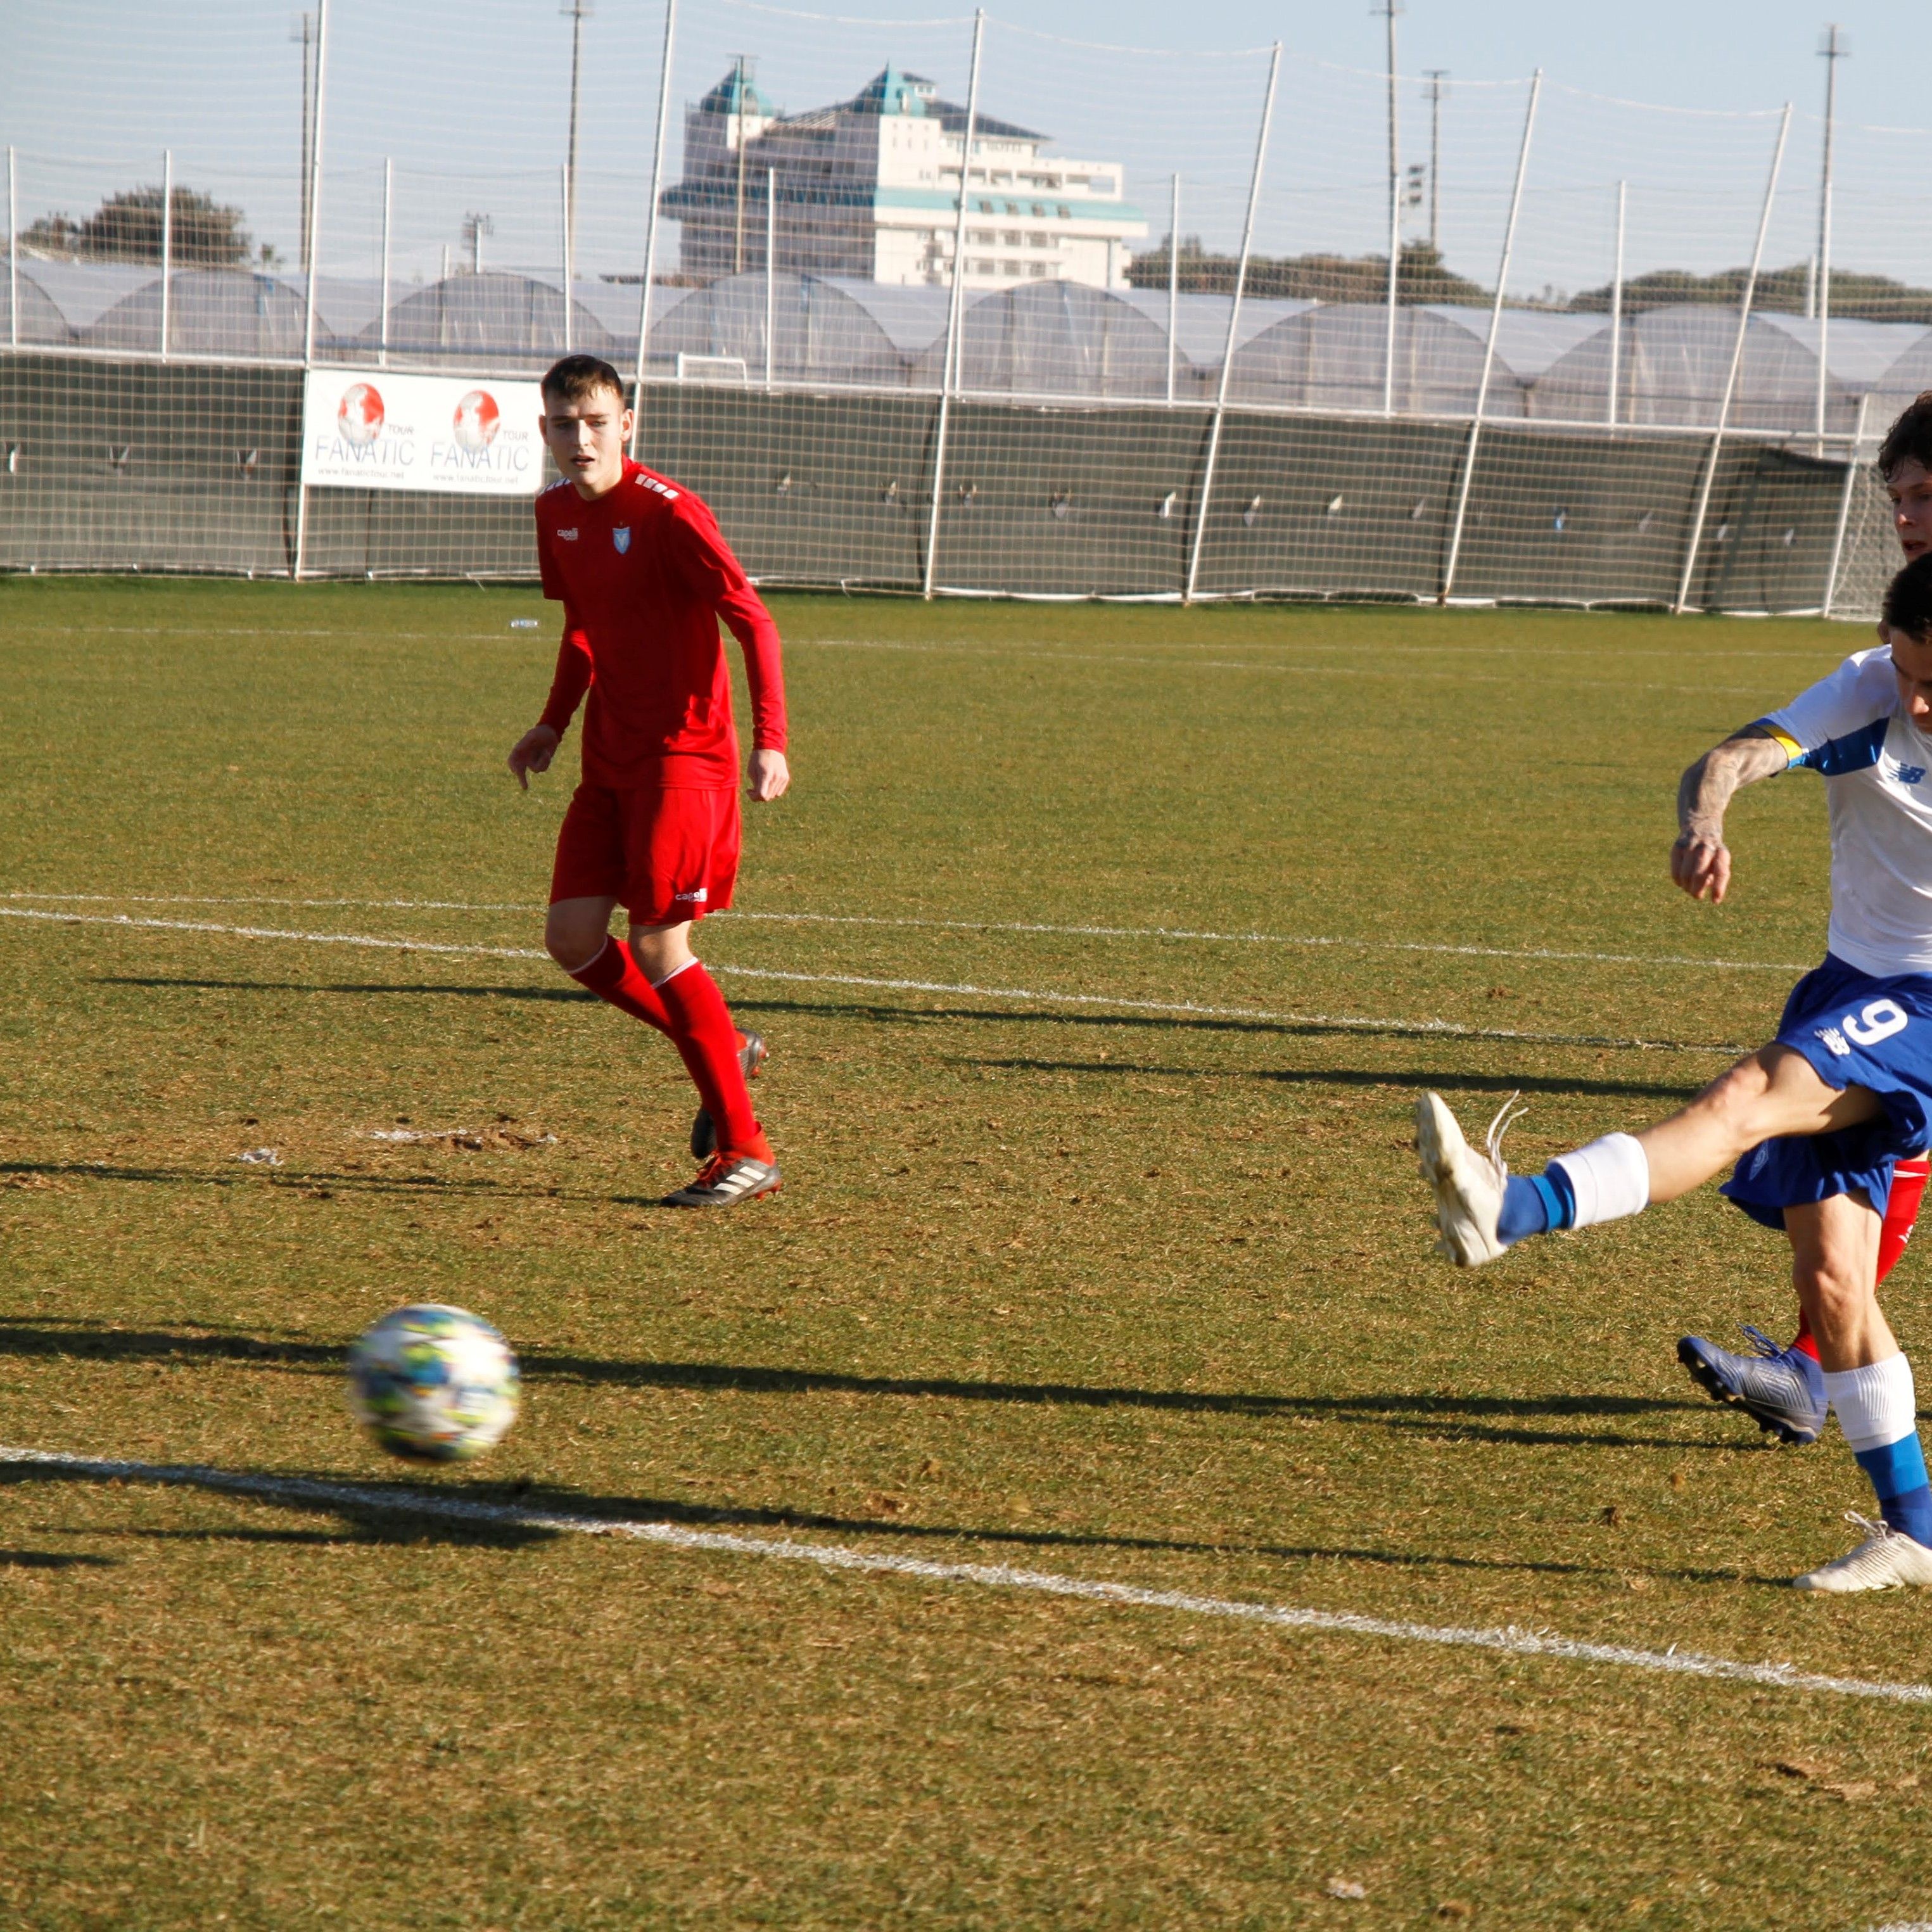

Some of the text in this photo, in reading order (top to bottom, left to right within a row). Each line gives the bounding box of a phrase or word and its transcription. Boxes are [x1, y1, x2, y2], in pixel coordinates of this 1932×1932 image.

[388, 424, 415, 435] TOUR
[503, 429, 529, 442] TOUR
[315, 435, 415, 466] FANATIC
[431, 442, 530, 471] FANATIC
[675, 887, 708, 900] cape
[1841, 998, 1909, 1046] 9
